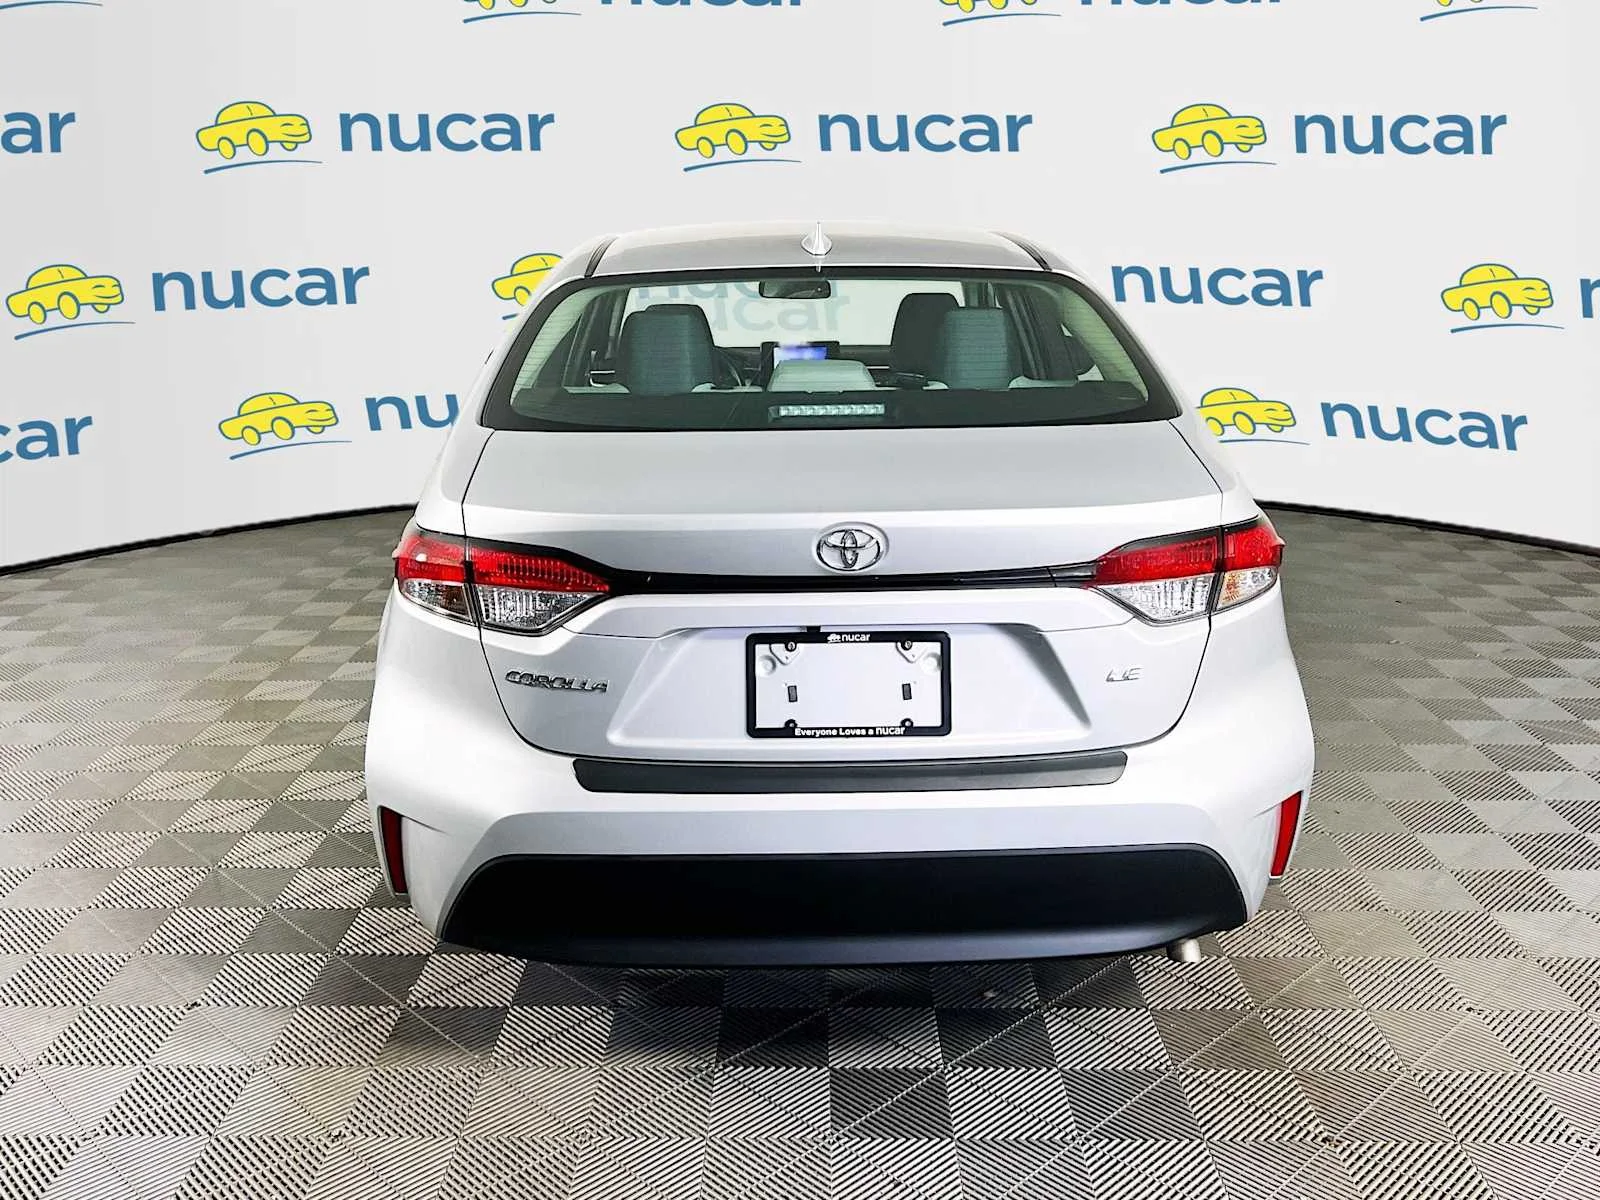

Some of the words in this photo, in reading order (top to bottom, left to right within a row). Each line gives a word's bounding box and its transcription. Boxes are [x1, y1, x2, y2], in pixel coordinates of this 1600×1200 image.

[339, 112, 555, 152] nucar
[818, 113, 1033, 153] nucar
[1294, 113, 1507, 155] nucar
[152, 265, 370, 312] nucar
[1111, 264, 1323, 308] nucar
[1320, 401, 1528, 452] nucar
[841, 633, 871, 642] nucar
[505, 670, 609, 693] COROLLA
[794, 728, 838, 737] Everyone
[839, 728, 866, 736] Loves
[875, 727, 906, 735] nucar
